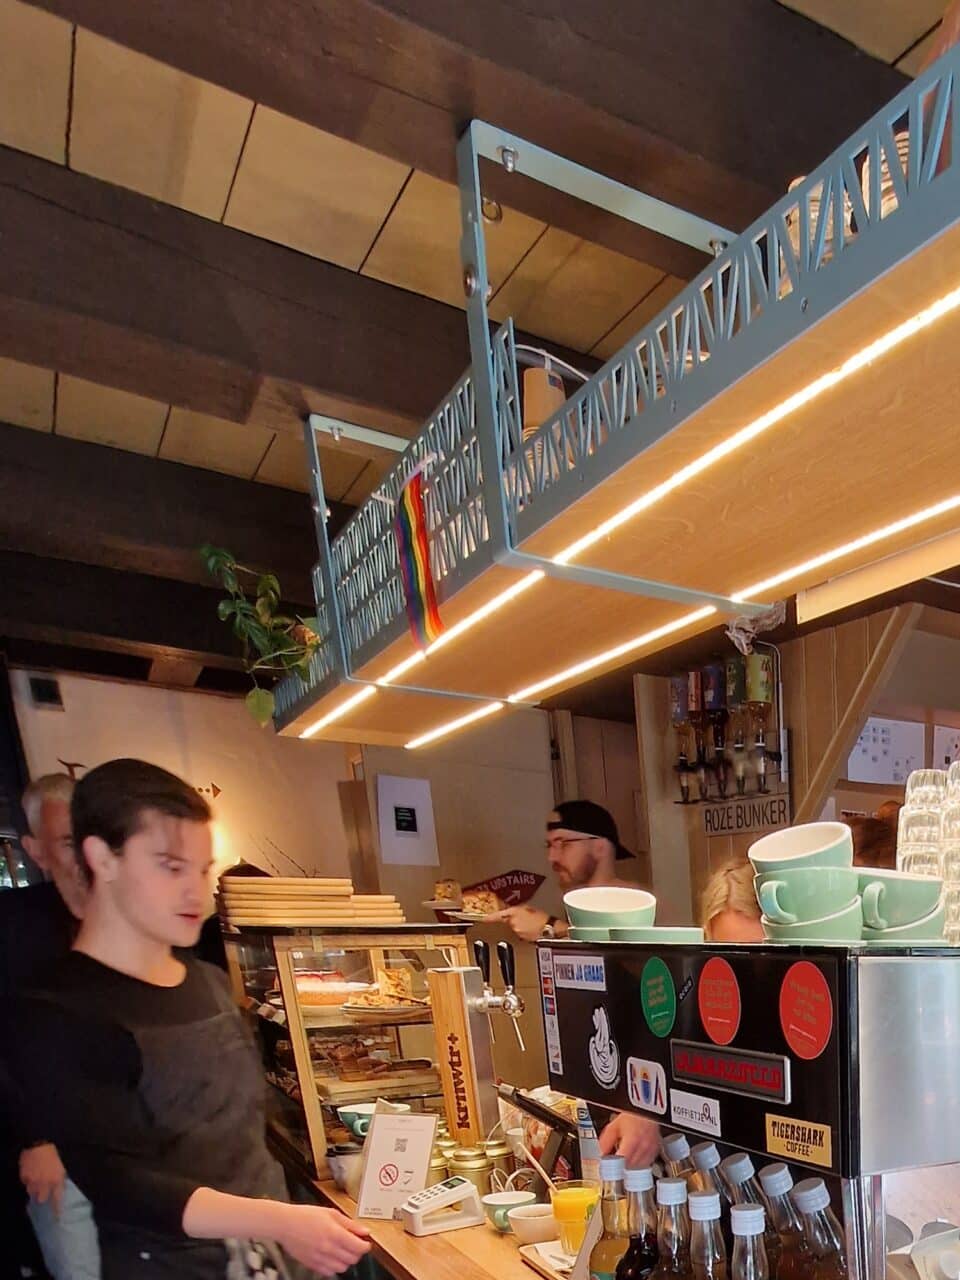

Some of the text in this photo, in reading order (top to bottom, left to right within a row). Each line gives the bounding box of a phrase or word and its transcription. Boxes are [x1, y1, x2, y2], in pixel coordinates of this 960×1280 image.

[704, 799, 787, 832] ROZE BUNKER
[490, 873, 536, 890] UPSTAIRS
[555, 963, 575, 980] PINNEN
[771, 1120, 825, 1147] TIGERSHARK
